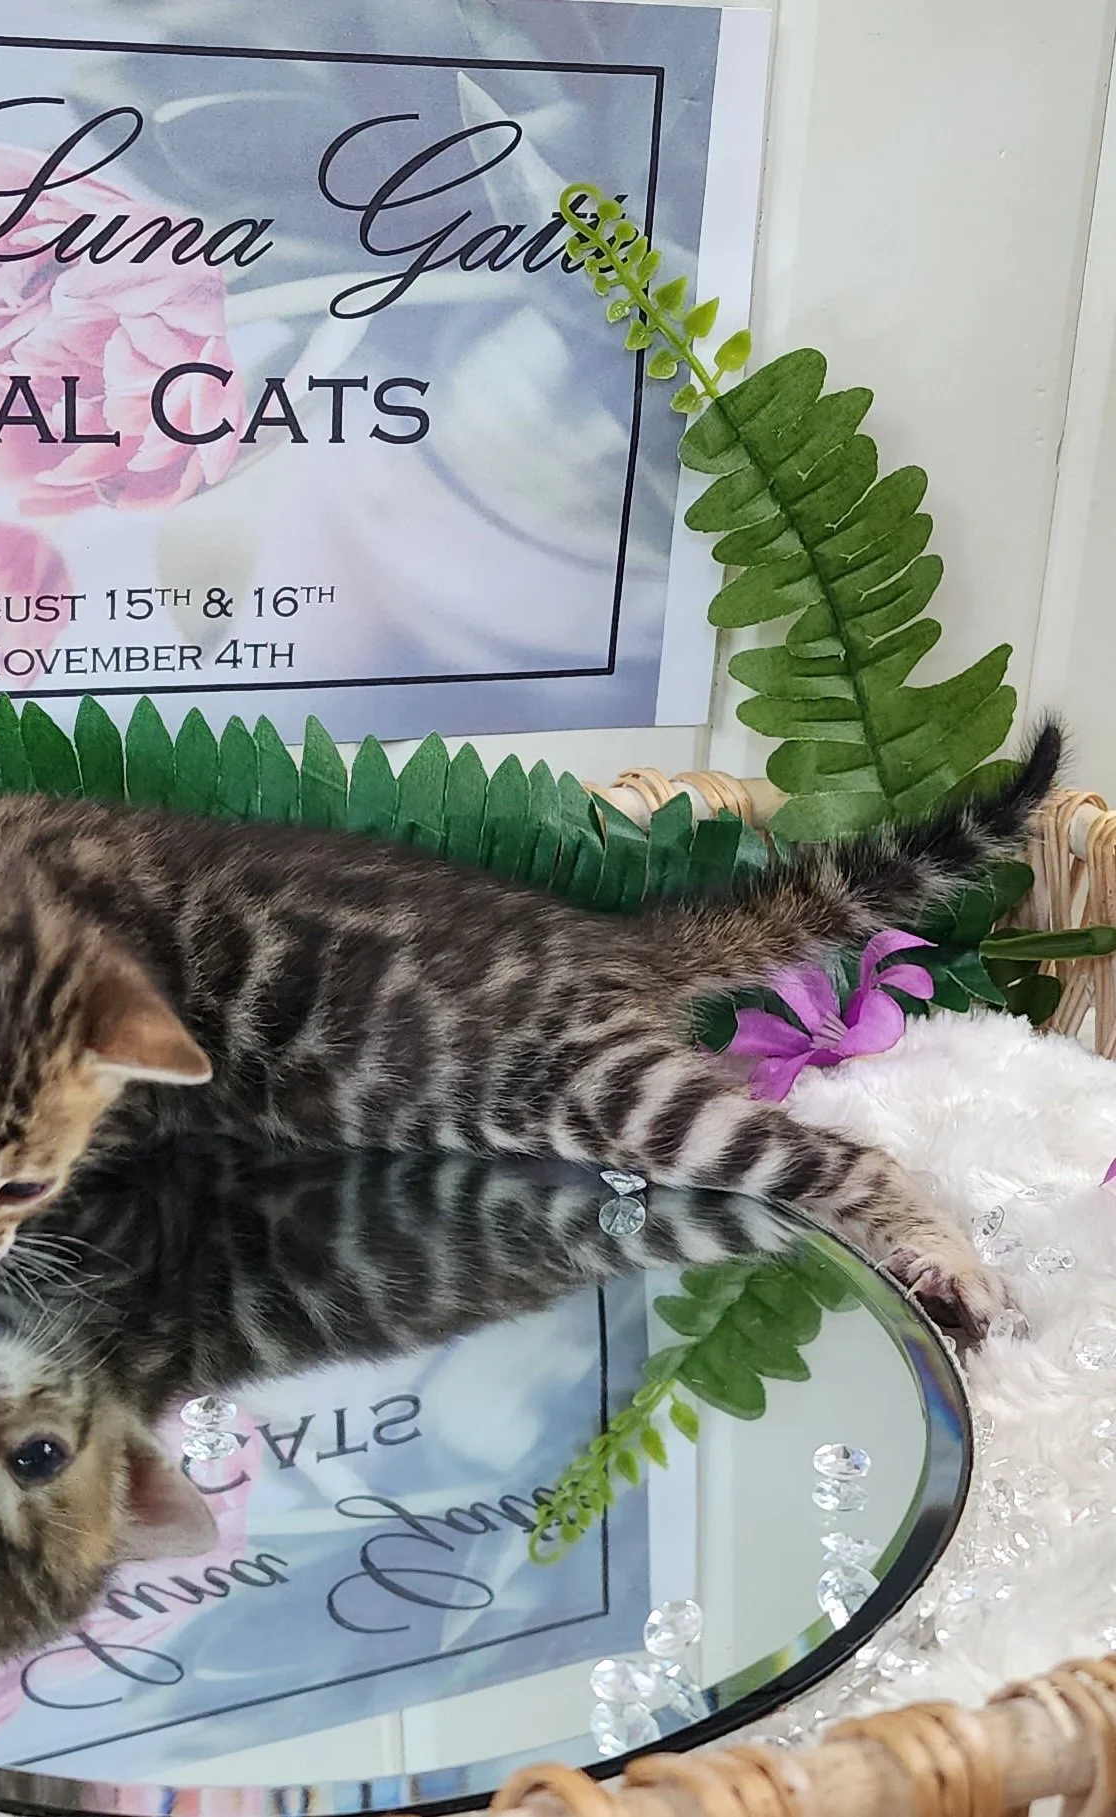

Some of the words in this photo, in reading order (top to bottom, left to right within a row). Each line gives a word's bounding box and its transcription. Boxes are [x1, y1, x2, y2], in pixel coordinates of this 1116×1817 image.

[151, 362, 431, 446] CATS
[105, 587, 192, 621] 15TH
[202, 587, 234, 619] &
[253, 585, 336, 618] 16TH
[214, 639, 296, 669] 4TH
